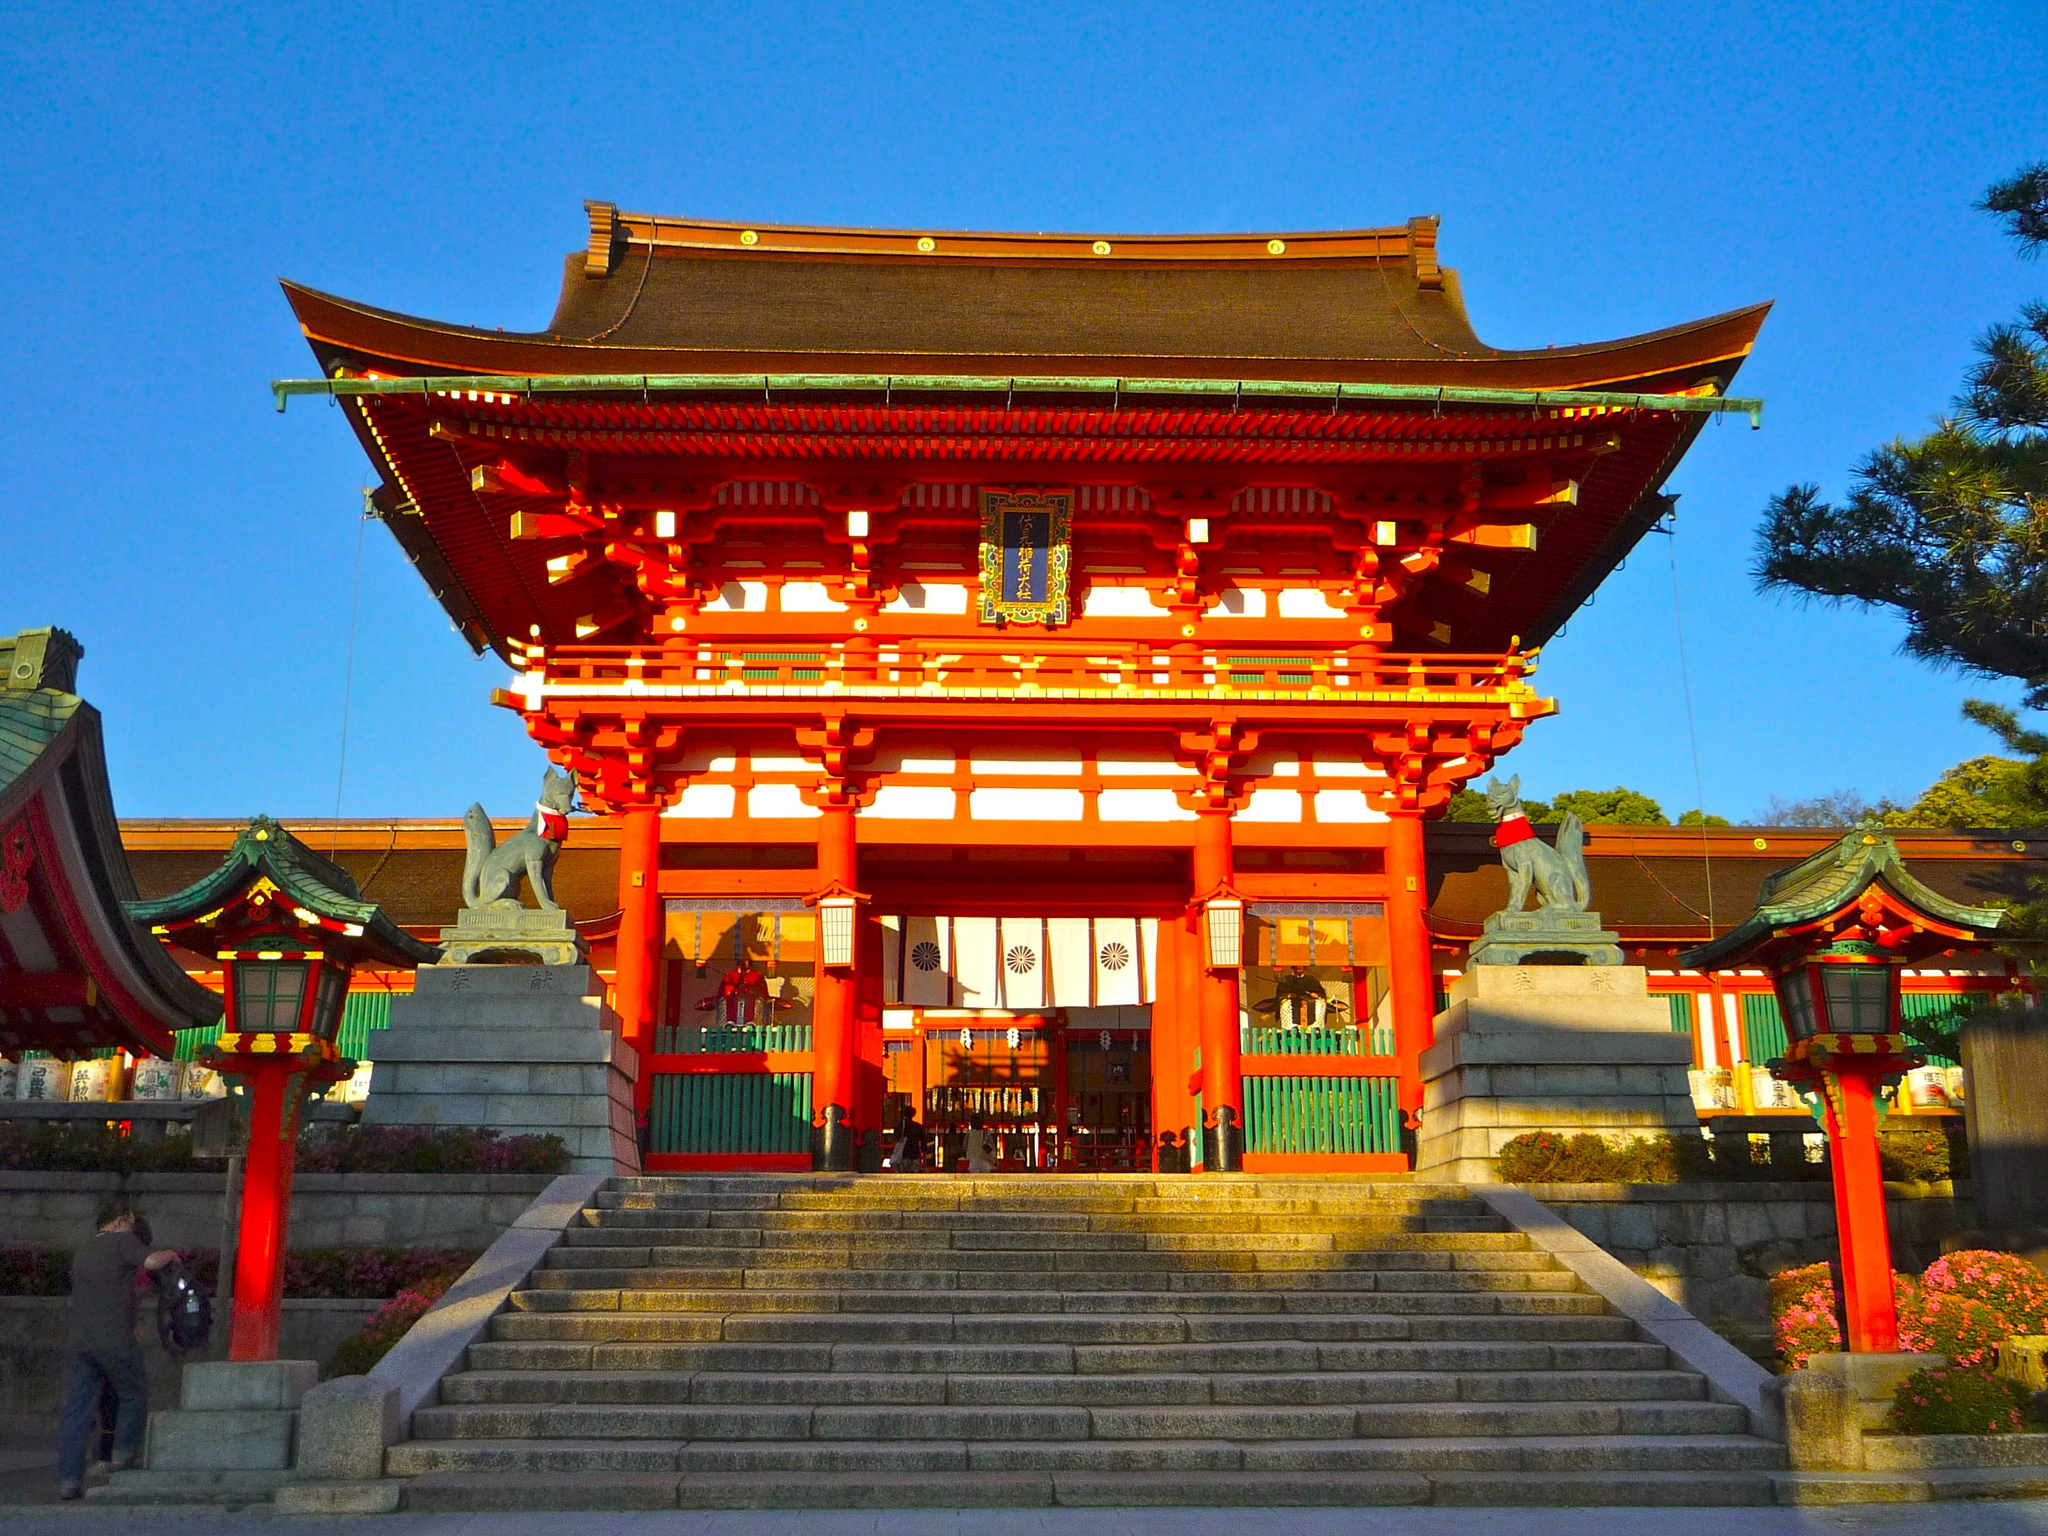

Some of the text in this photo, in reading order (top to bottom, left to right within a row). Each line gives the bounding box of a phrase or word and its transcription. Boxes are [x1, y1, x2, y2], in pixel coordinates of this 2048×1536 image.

[1016, 514, 1034, 601] 伏見稲荷大社
